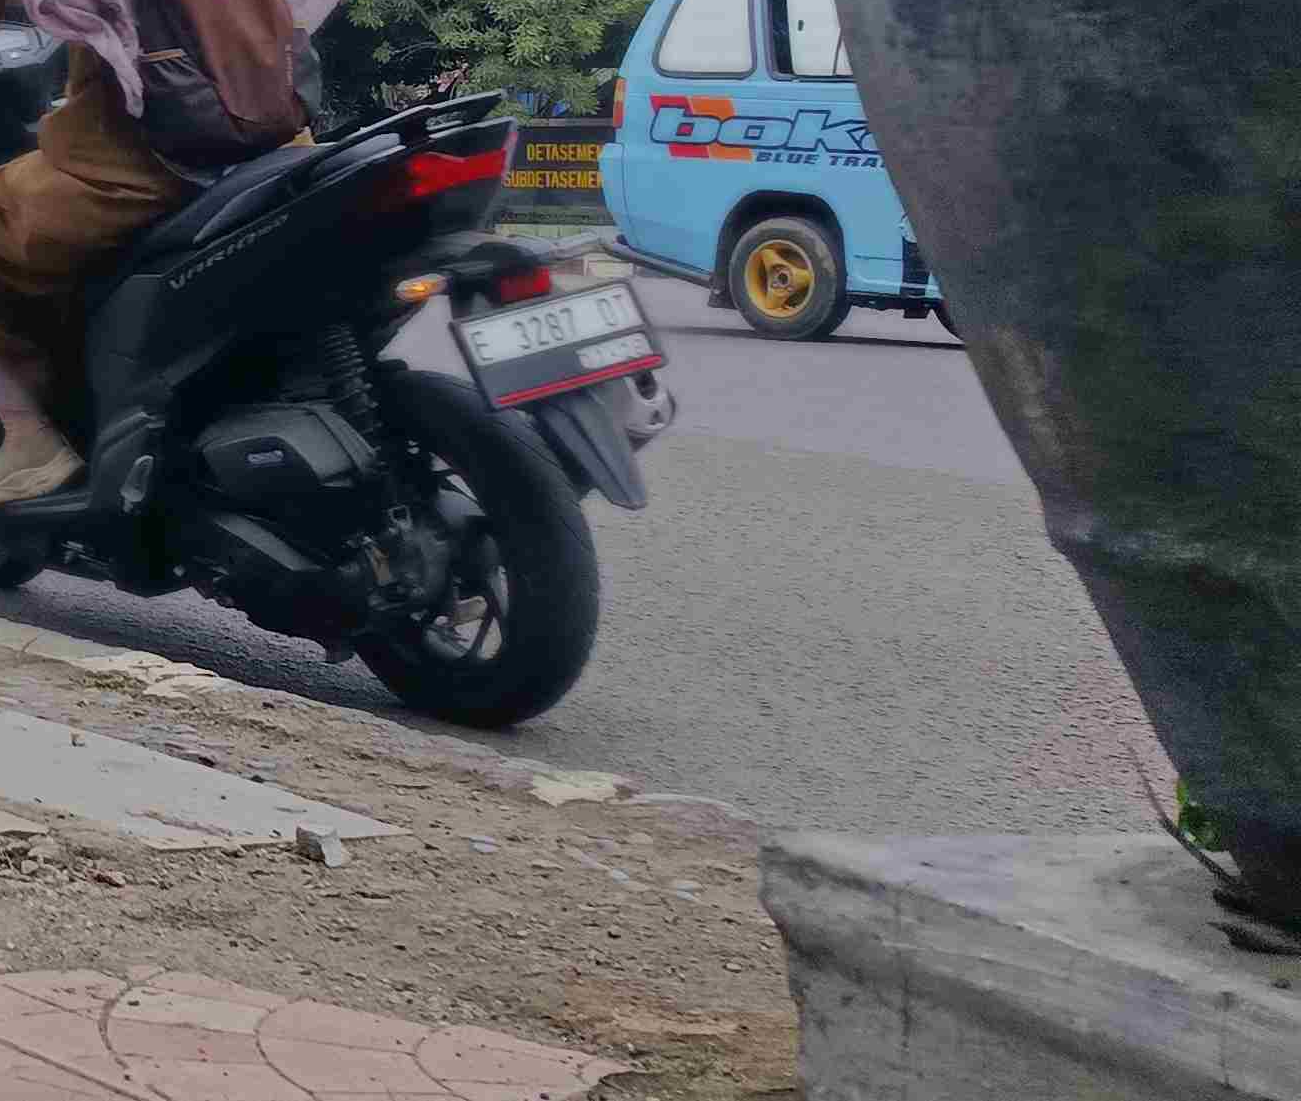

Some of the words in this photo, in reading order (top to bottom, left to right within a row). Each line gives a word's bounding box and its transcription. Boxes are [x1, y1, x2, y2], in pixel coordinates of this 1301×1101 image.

[755, 151, 820, 166] BLUE
[828, 154, 888, 169] TRA
[470, 330, 494, 362] E
[512, 307, 577, 350] 3287
